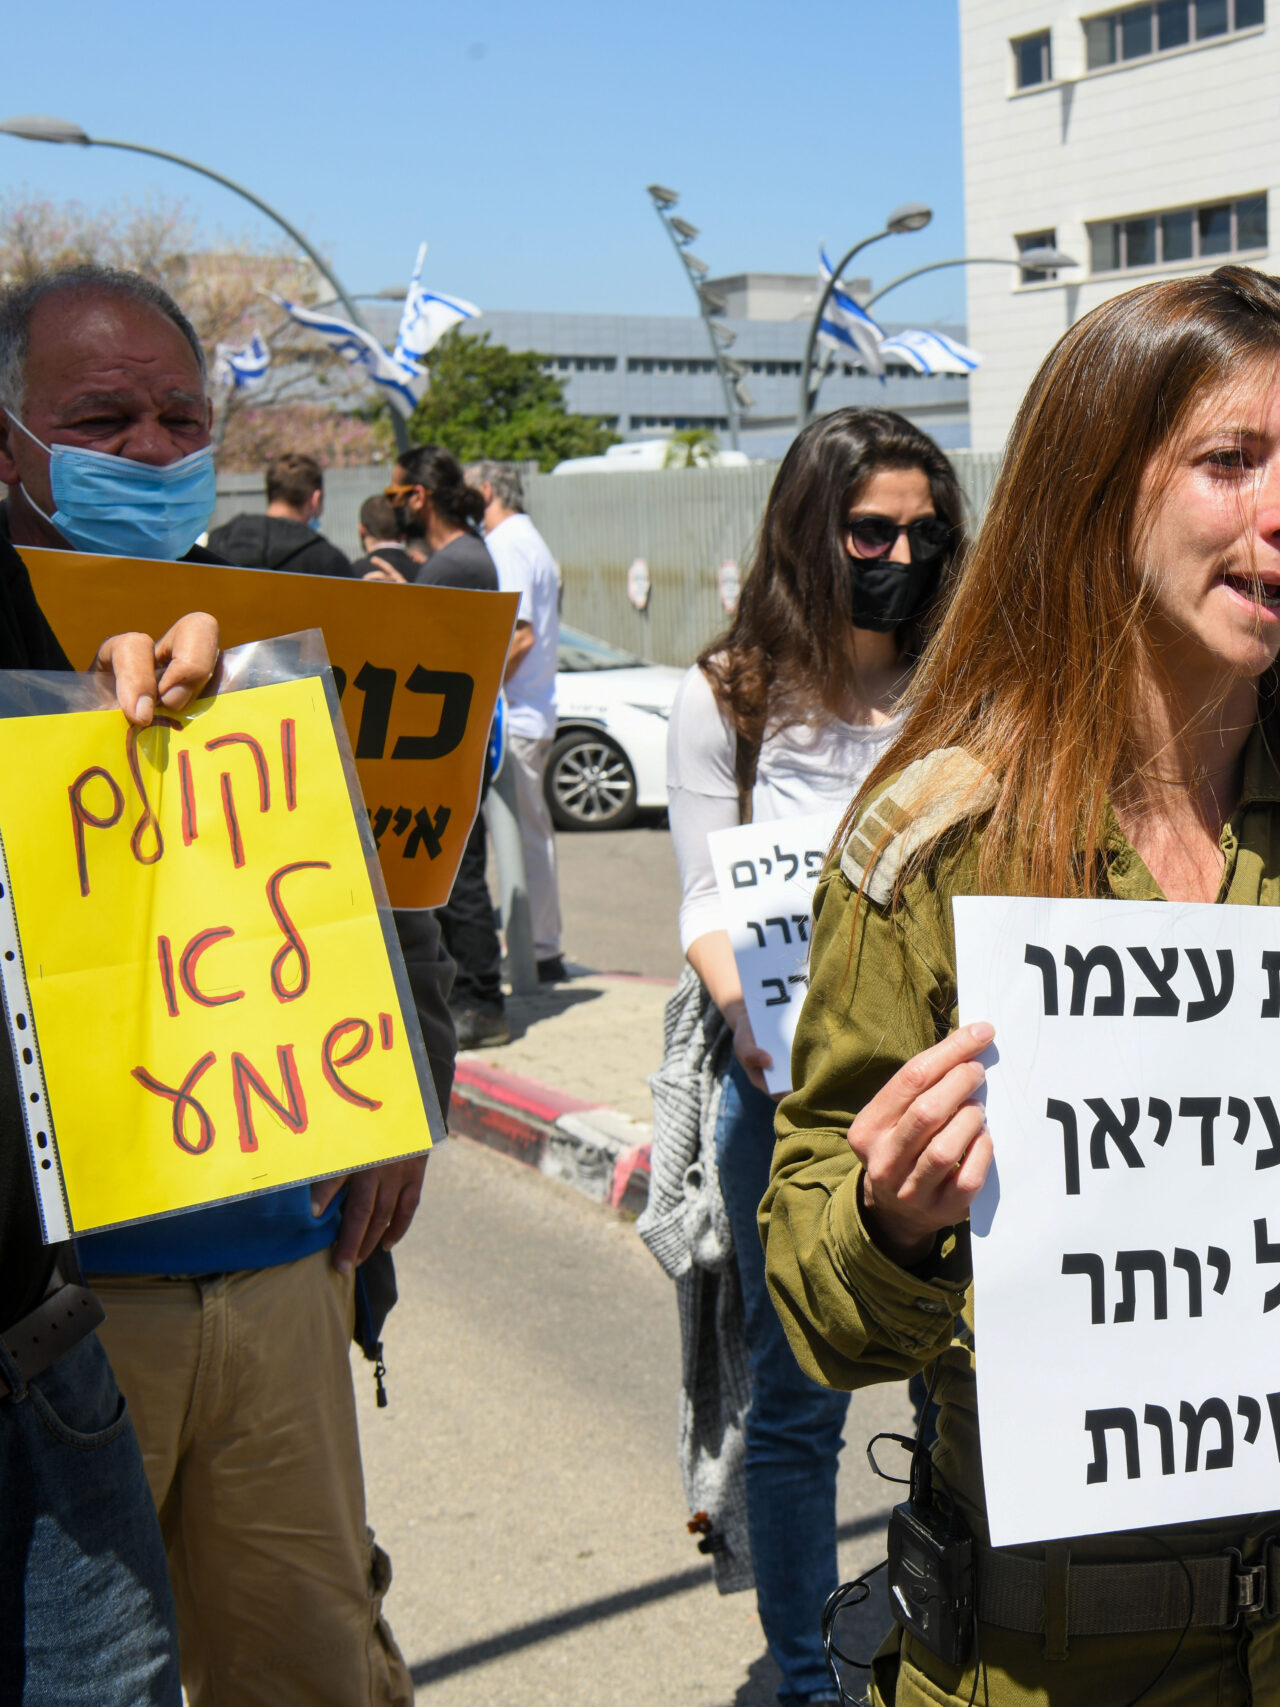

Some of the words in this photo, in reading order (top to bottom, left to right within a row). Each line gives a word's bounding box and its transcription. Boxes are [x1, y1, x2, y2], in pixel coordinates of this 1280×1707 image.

[331, 660, 475, 761] כו
[67, 716, 297, 897] וקולם
[157, 860, 332, 1017] לא
[1024, 943, 1235, 1023] עצמו
[130, 1012, 394, 1156] ישמע
[1061, 1245, 1231, 1325] יותר
